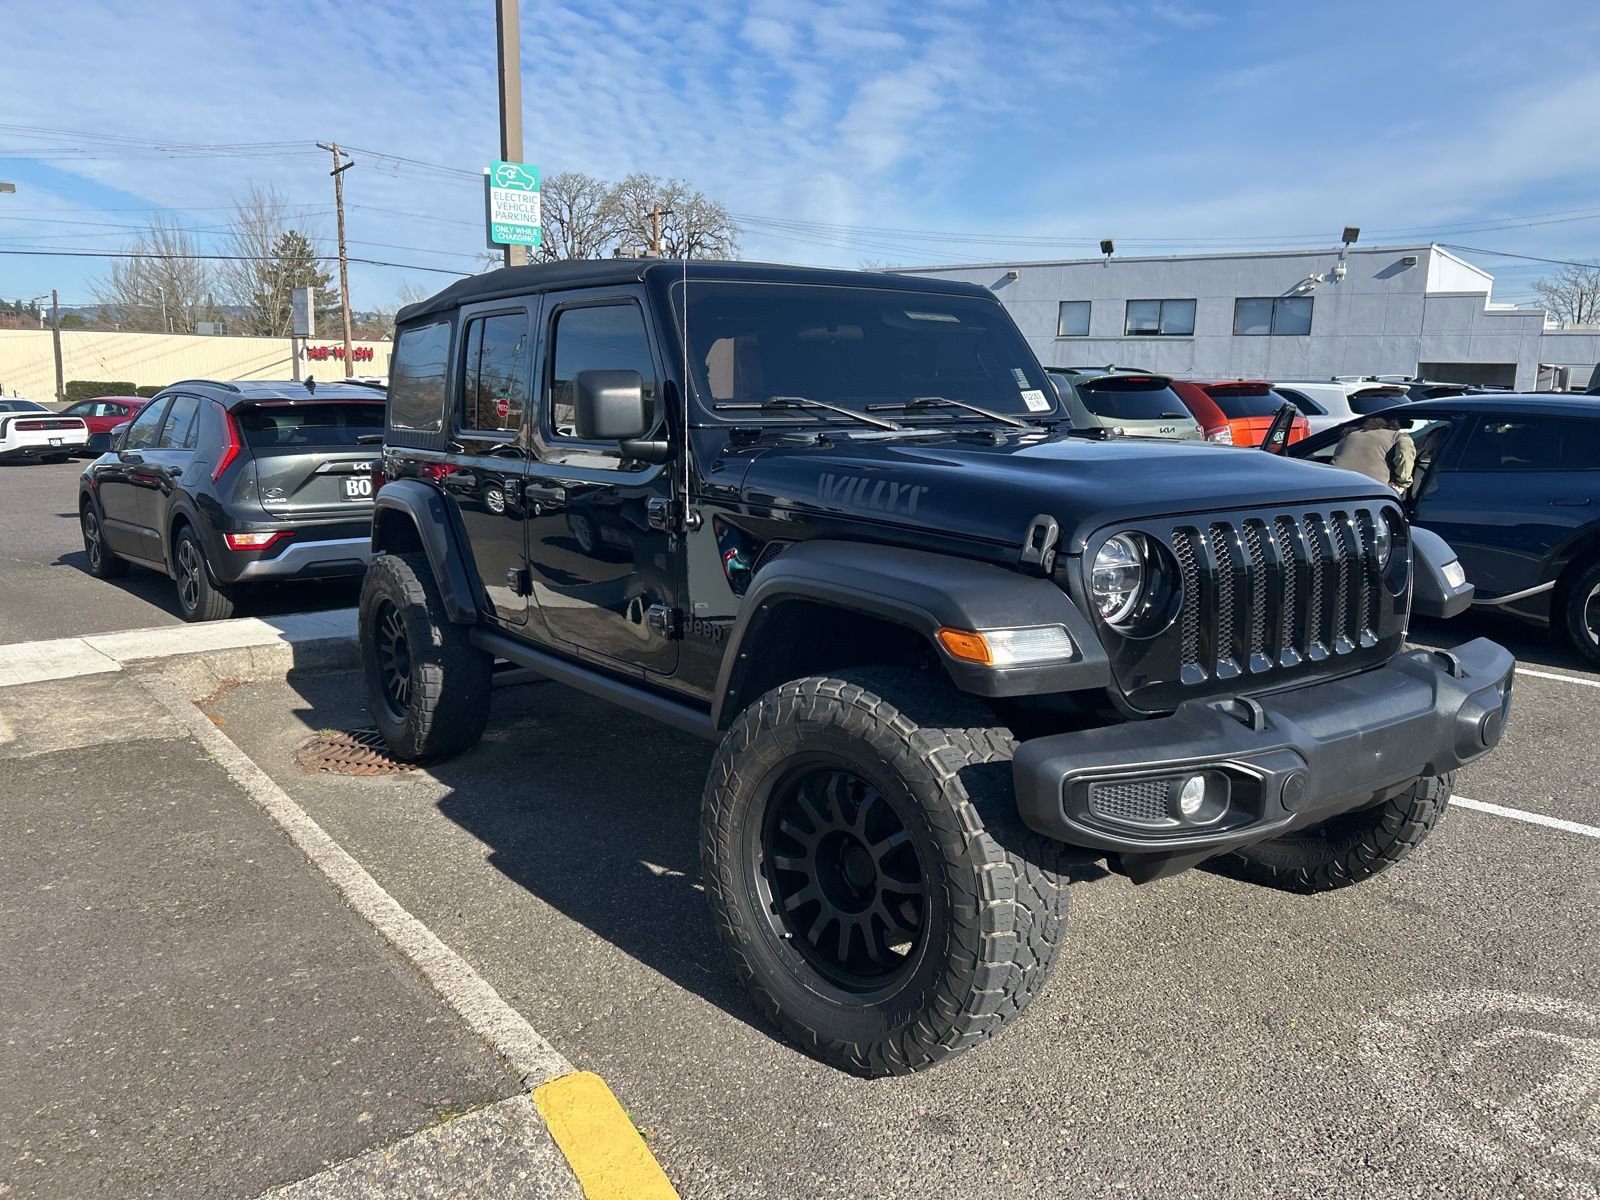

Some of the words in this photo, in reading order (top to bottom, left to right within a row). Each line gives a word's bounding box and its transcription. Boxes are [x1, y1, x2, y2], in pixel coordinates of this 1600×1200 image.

[493, 192, 538, 204] ELECTRIC
[496, 202, 536, 213] VEHICLE
[495, 211, 537, 223] PARKING
[495, 225, 514, 233] ONLY
[515, 227, 538, 235] WHILE
[498, 232, 535, 242] CHARGING
[817, 472, 929, 515] WILLYS
[683, 619, 721, 644] Jeep
